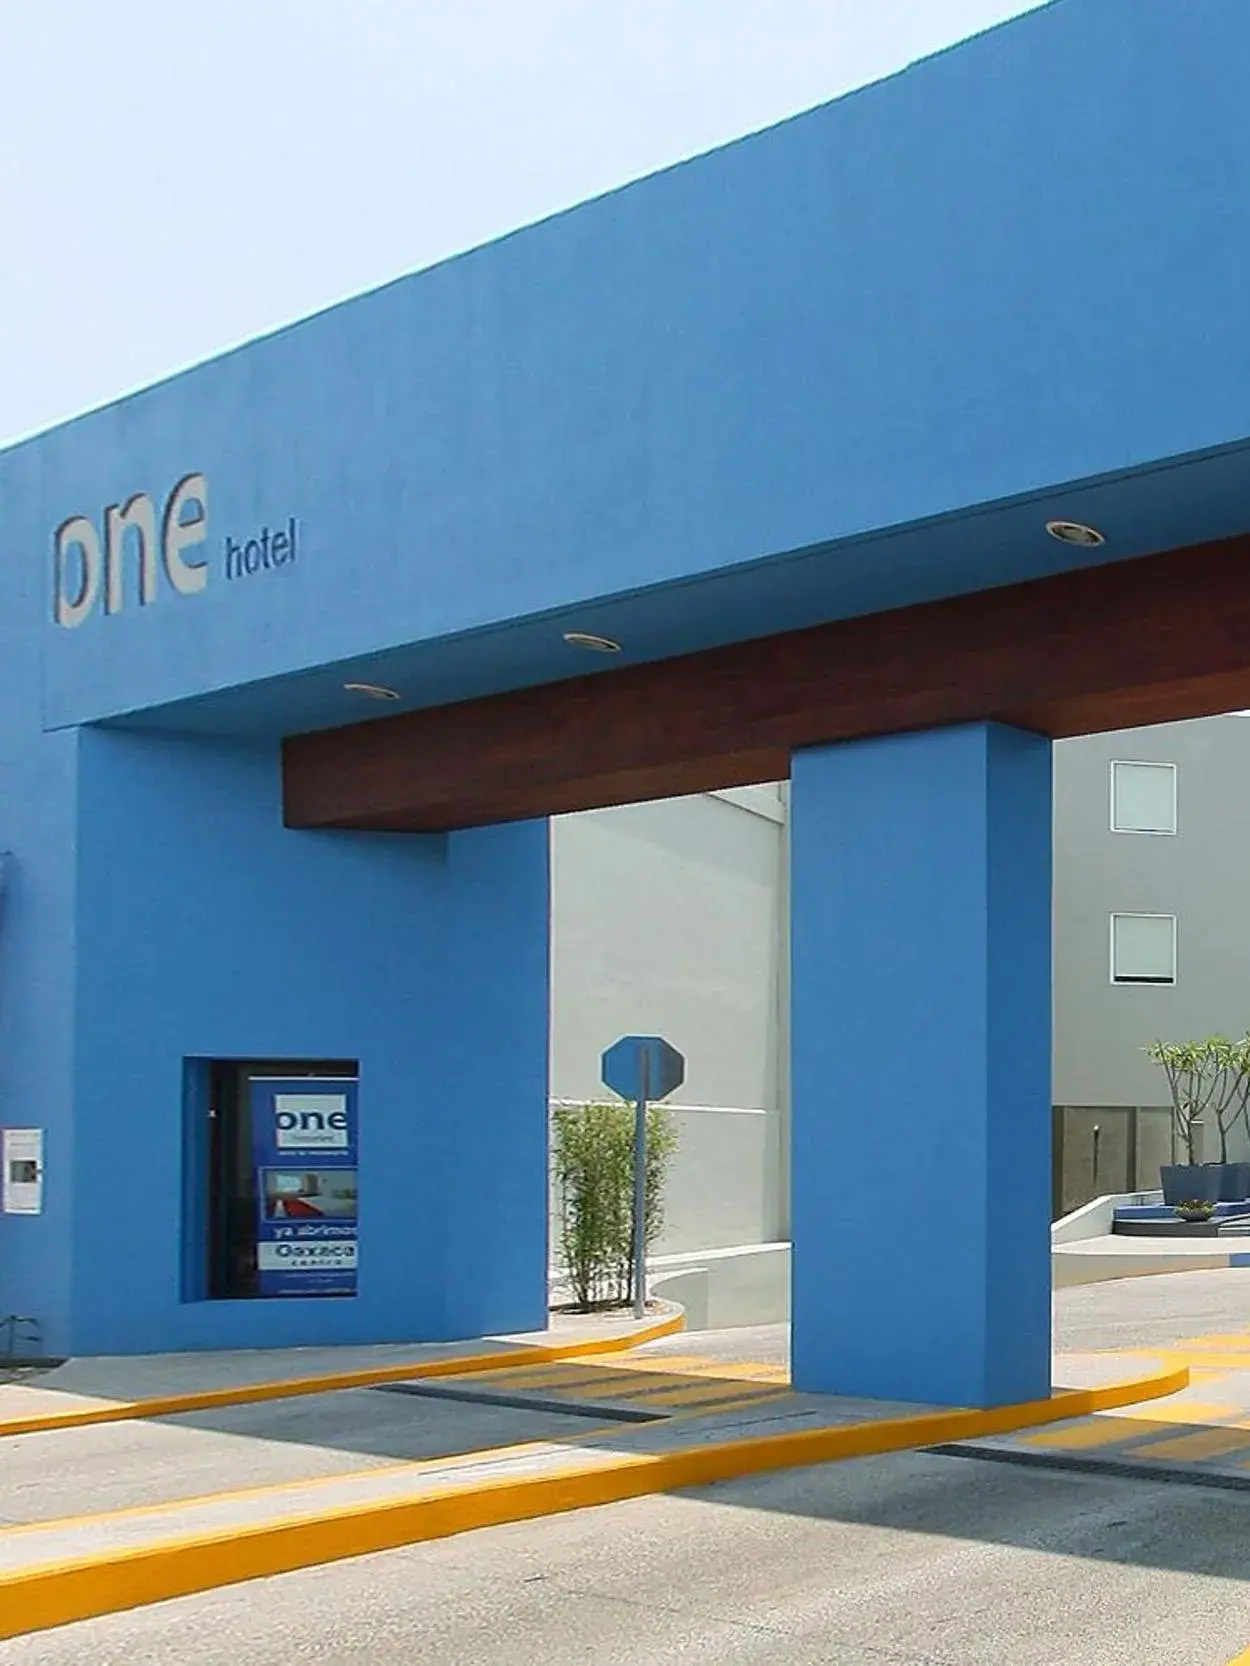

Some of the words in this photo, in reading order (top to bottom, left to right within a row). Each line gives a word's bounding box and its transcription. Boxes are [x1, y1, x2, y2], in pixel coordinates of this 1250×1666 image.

[54, 472, 208, 629] one
[225, 517, 296, 580] hotel
[277, 1111, 347, 1130] one
[275, 1244, 354, 1257] Oaxaca
